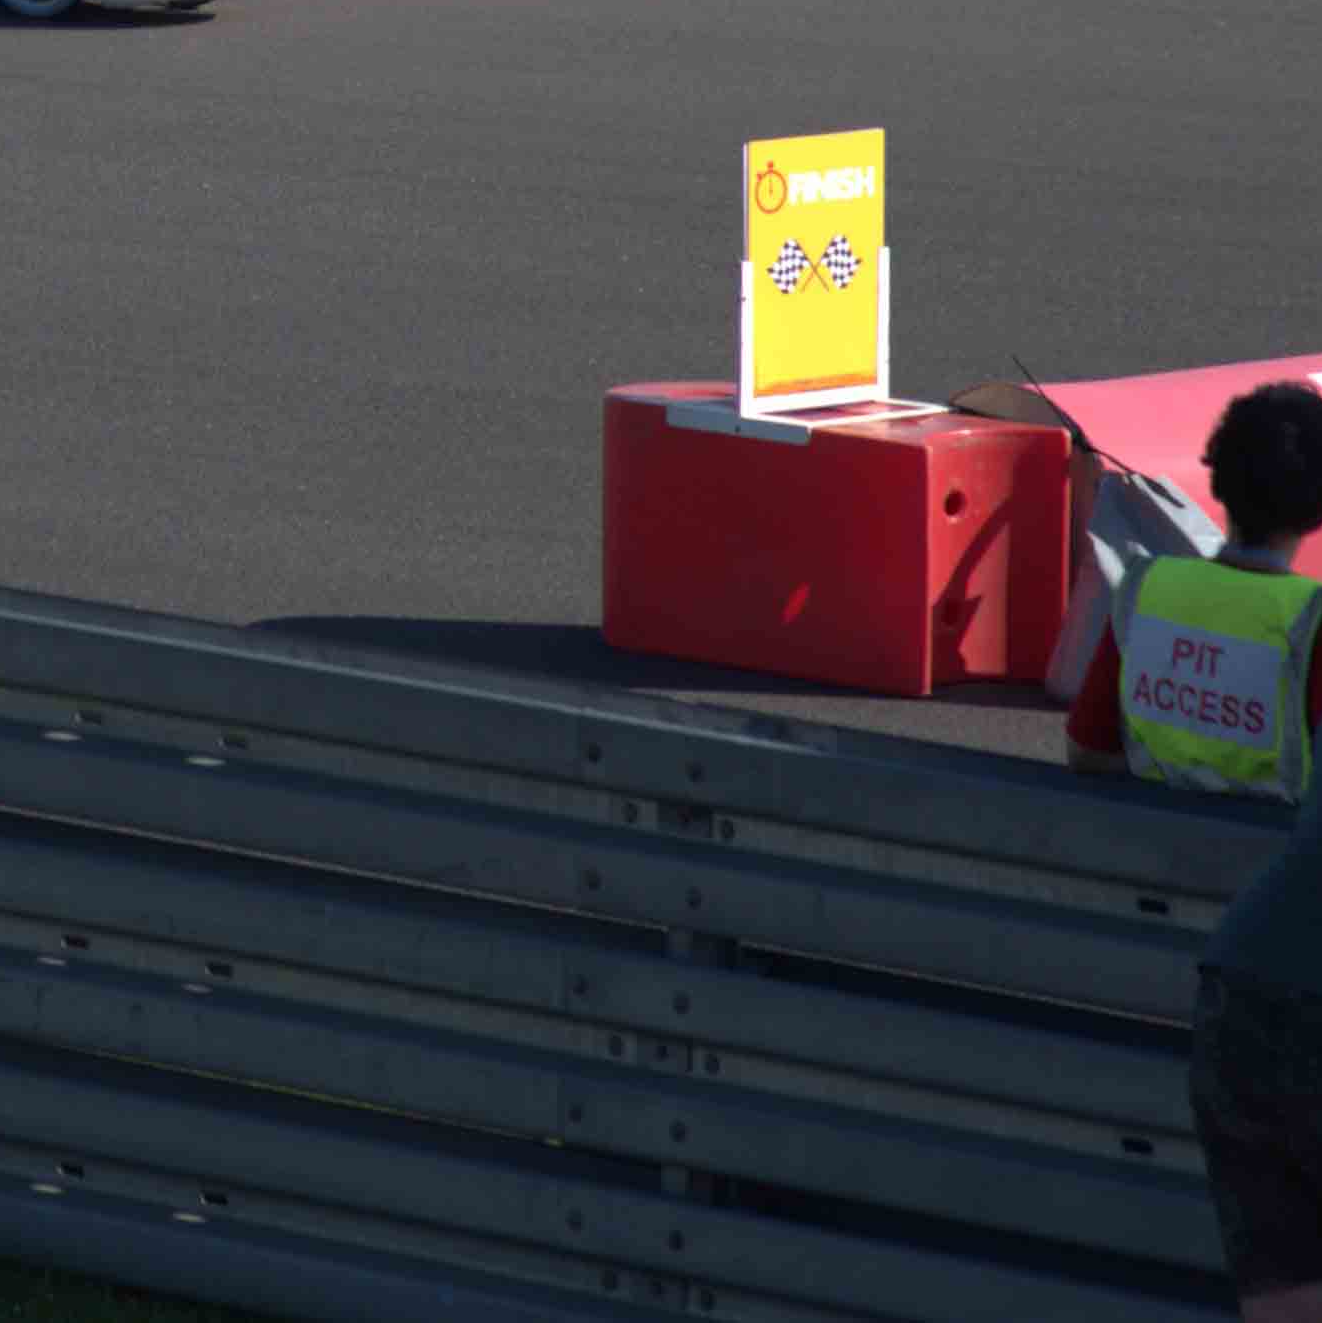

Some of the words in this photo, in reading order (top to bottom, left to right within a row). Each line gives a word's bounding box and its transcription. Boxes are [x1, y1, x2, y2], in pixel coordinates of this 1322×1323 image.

[788, 165, 875, 205] FINISH
[1171, 638, 1224, 679] PIT
[1132, 672, 1266, 735] ACCESS
